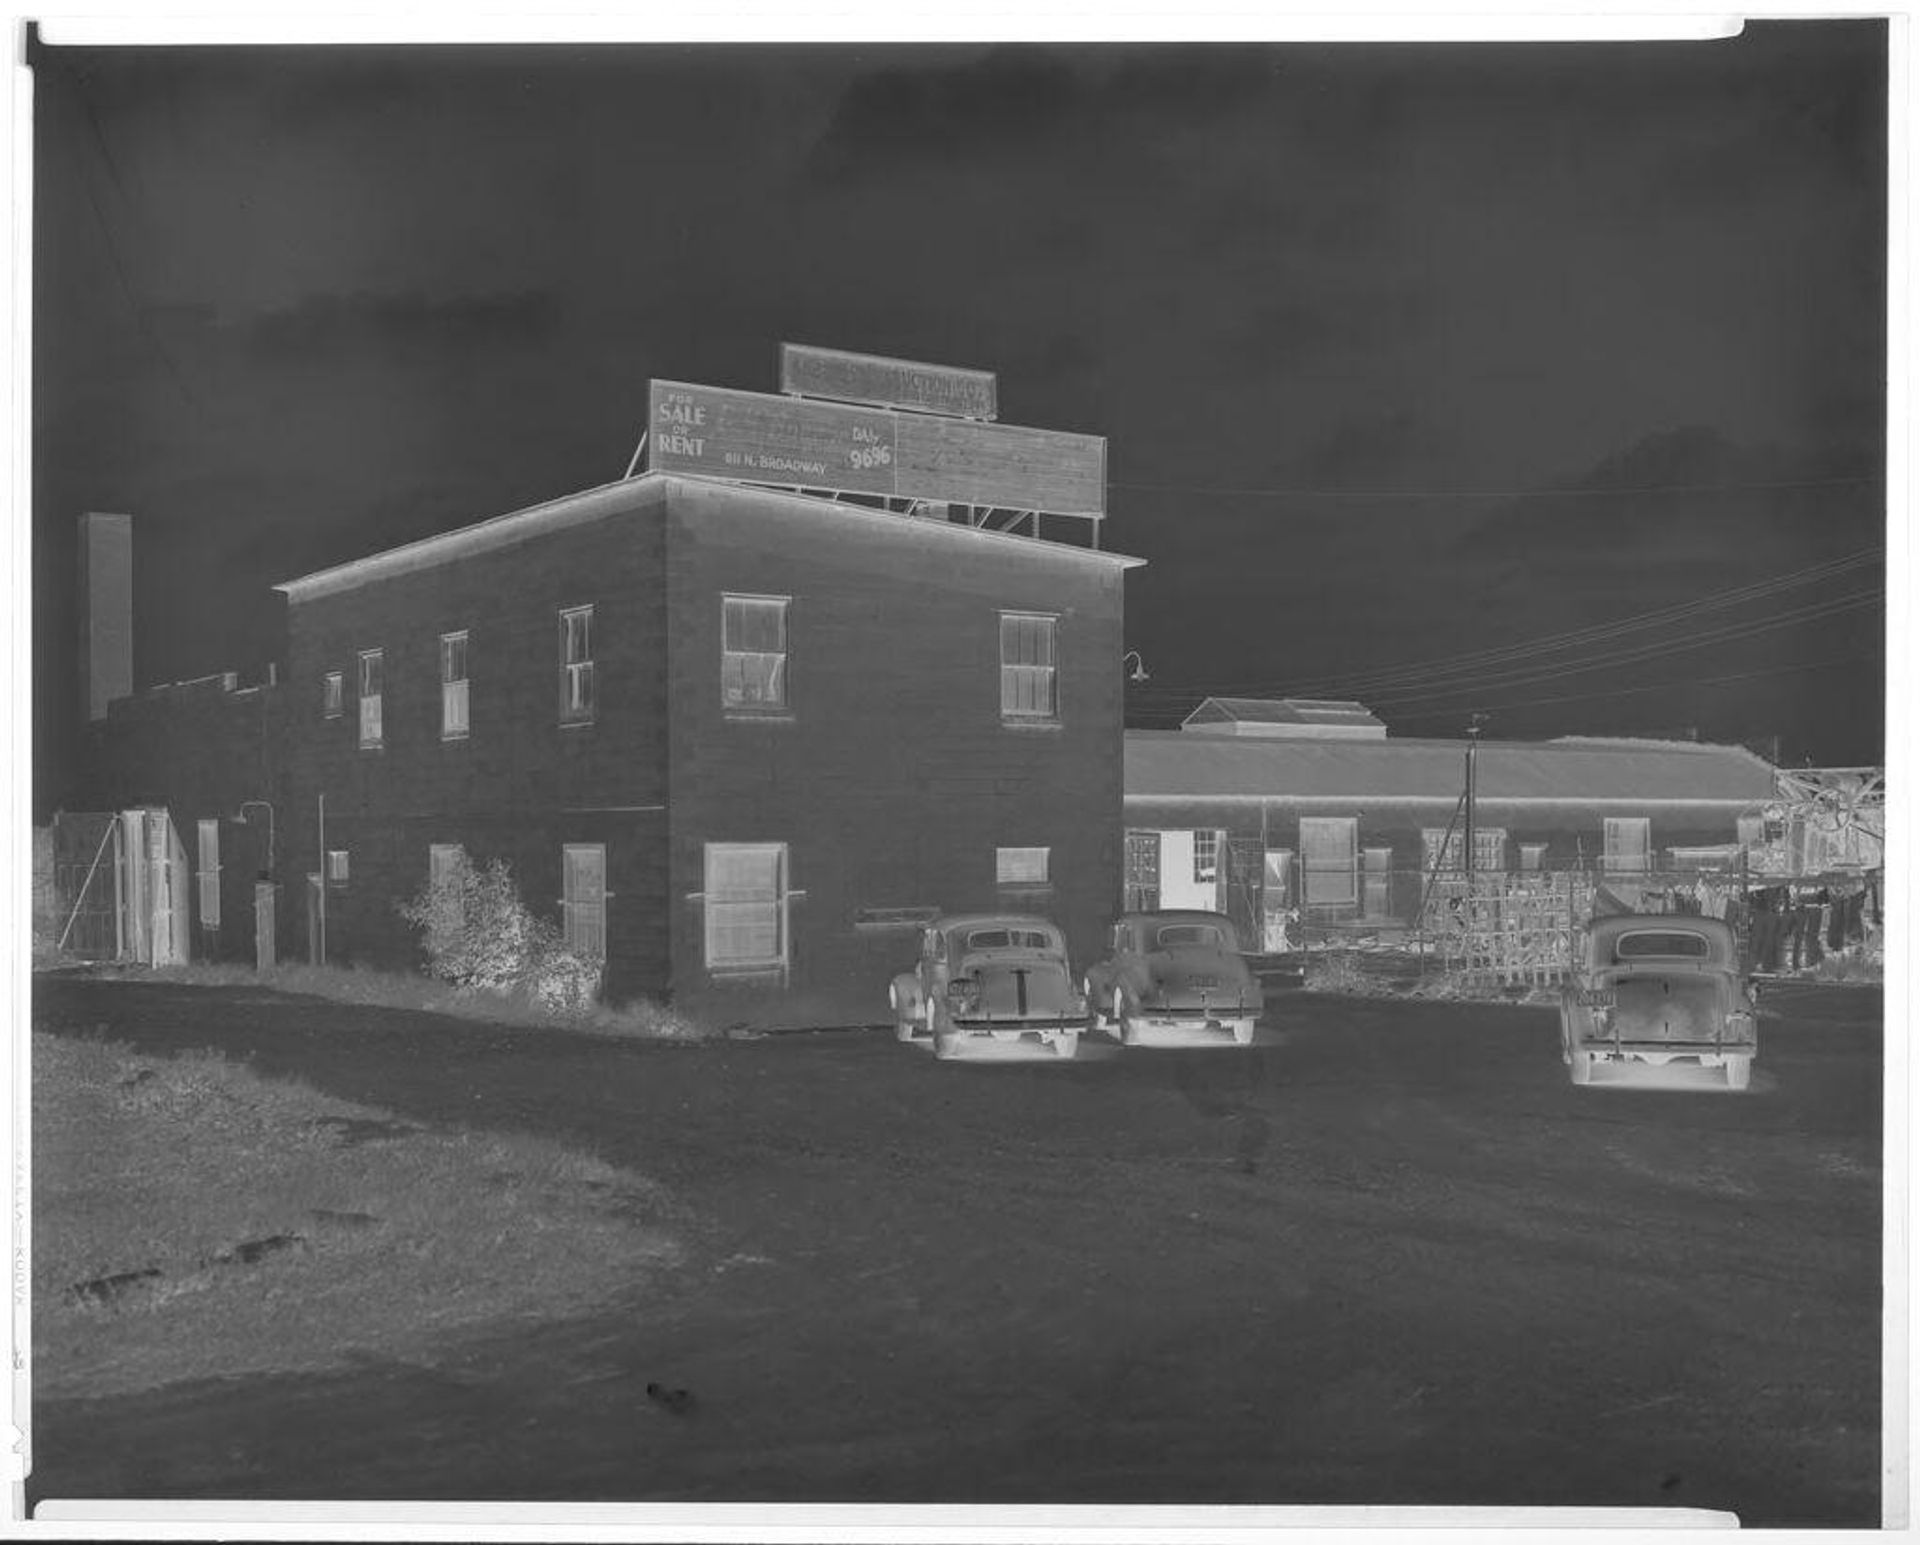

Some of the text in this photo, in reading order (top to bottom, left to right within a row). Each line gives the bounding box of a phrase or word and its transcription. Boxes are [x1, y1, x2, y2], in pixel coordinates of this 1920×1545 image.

[660, 403, 706, 425] SALE
[673, 426, 689, 436] OR
[660, 433, 706, 456] RENT
[760, 455, 826, 475] BROADWAY
[850, 445, 890, 469] 9696
